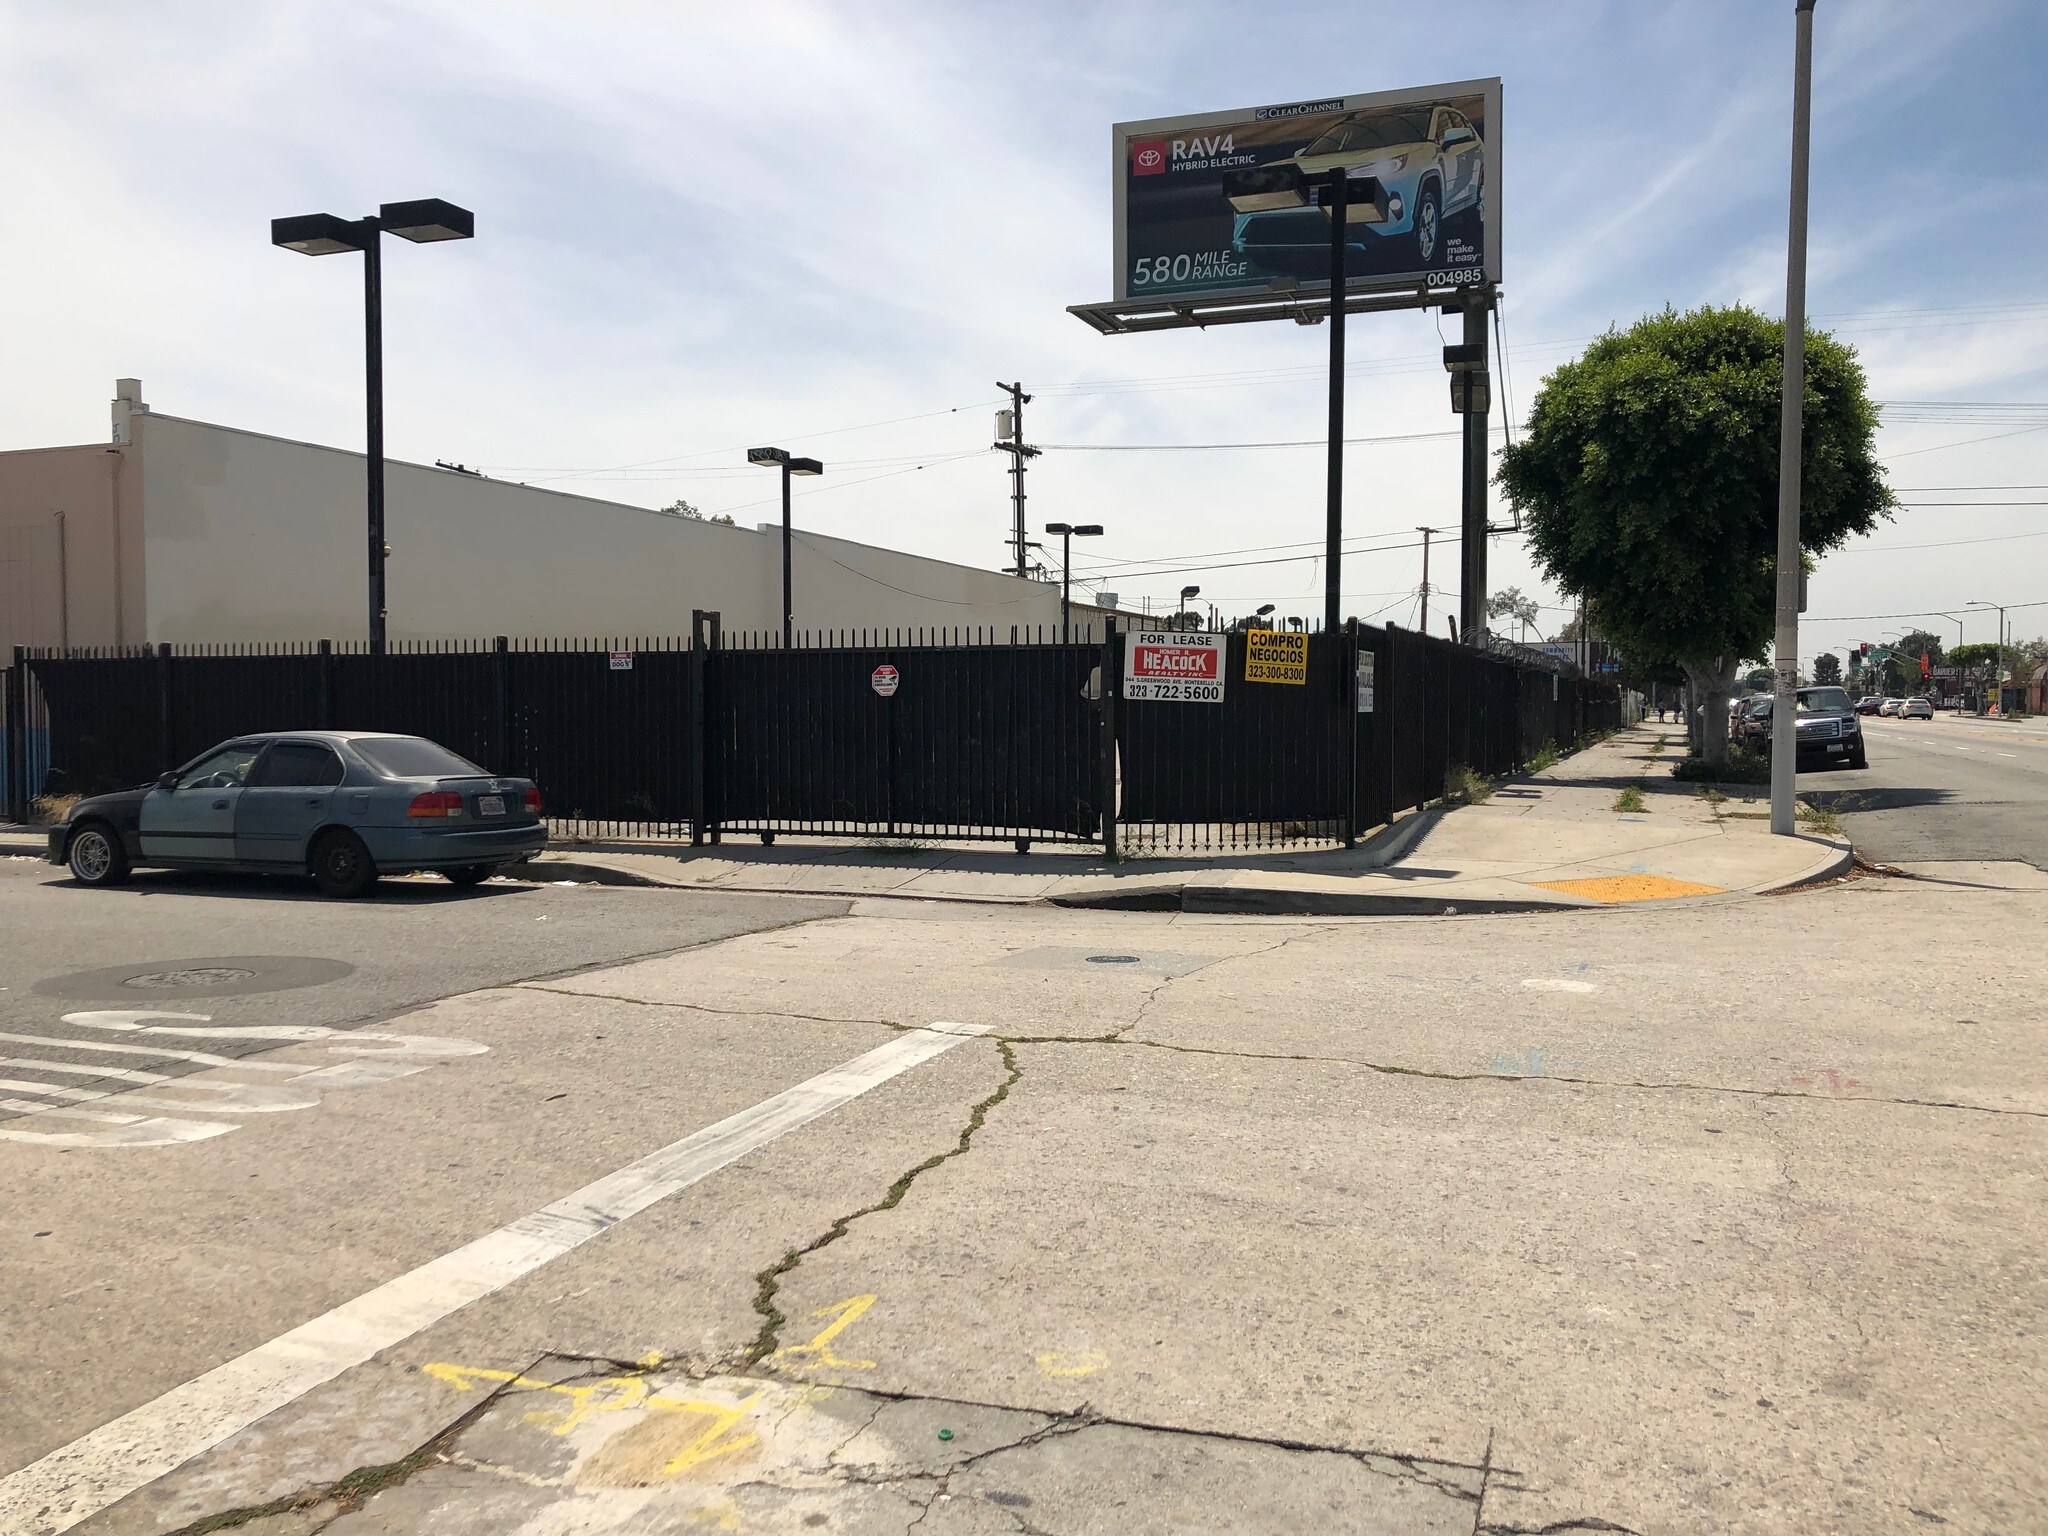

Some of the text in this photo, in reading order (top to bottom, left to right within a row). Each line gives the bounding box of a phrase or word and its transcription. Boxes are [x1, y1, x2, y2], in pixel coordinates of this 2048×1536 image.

[1172, 134, 1234, 160] RAV4
[1172, 154, 1256, 172] HYBRID ELECTRIC
[1447, 245, 1474, 254] make
[1447, 254, 1453, 262] it
[1133, 254, 1190, 285] 580
[1194, 250, 1230, 266] MILE
[1192, 262, 1248, 279] RANGE
[1428, 269, 1481, 286] 004985
[1140, 634, 1212, 645] FOR LEASE
[1251, 632, 1303, 649] COMPRO
[1143, 650, 1208, 671] HEACOCK
[1250, 648, 1304, 663] NEGOCIOS
[1249, 664, 1304, 680] 323-300-8300
